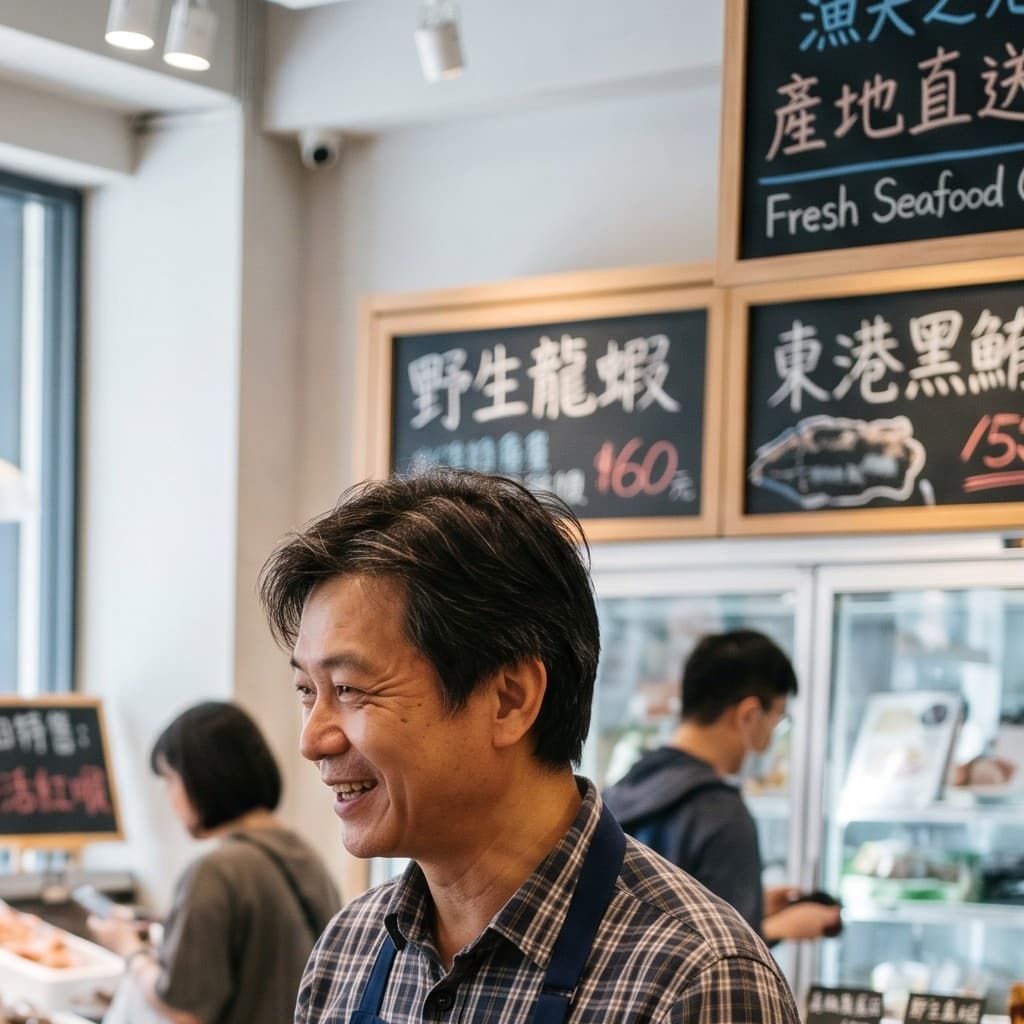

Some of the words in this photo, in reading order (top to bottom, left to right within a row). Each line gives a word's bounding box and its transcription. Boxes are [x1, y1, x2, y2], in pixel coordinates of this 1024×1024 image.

[799, 0, 1024, 50] 漁夫
[765, 41, 1024, 161] 產地直送
[765, 184, 859, 238] Fresh
[872, 163, 1005, 224] Seafood
[407, 333, 681, 432] 野生龍蝦
[959, 412, 1024, 469] 15
